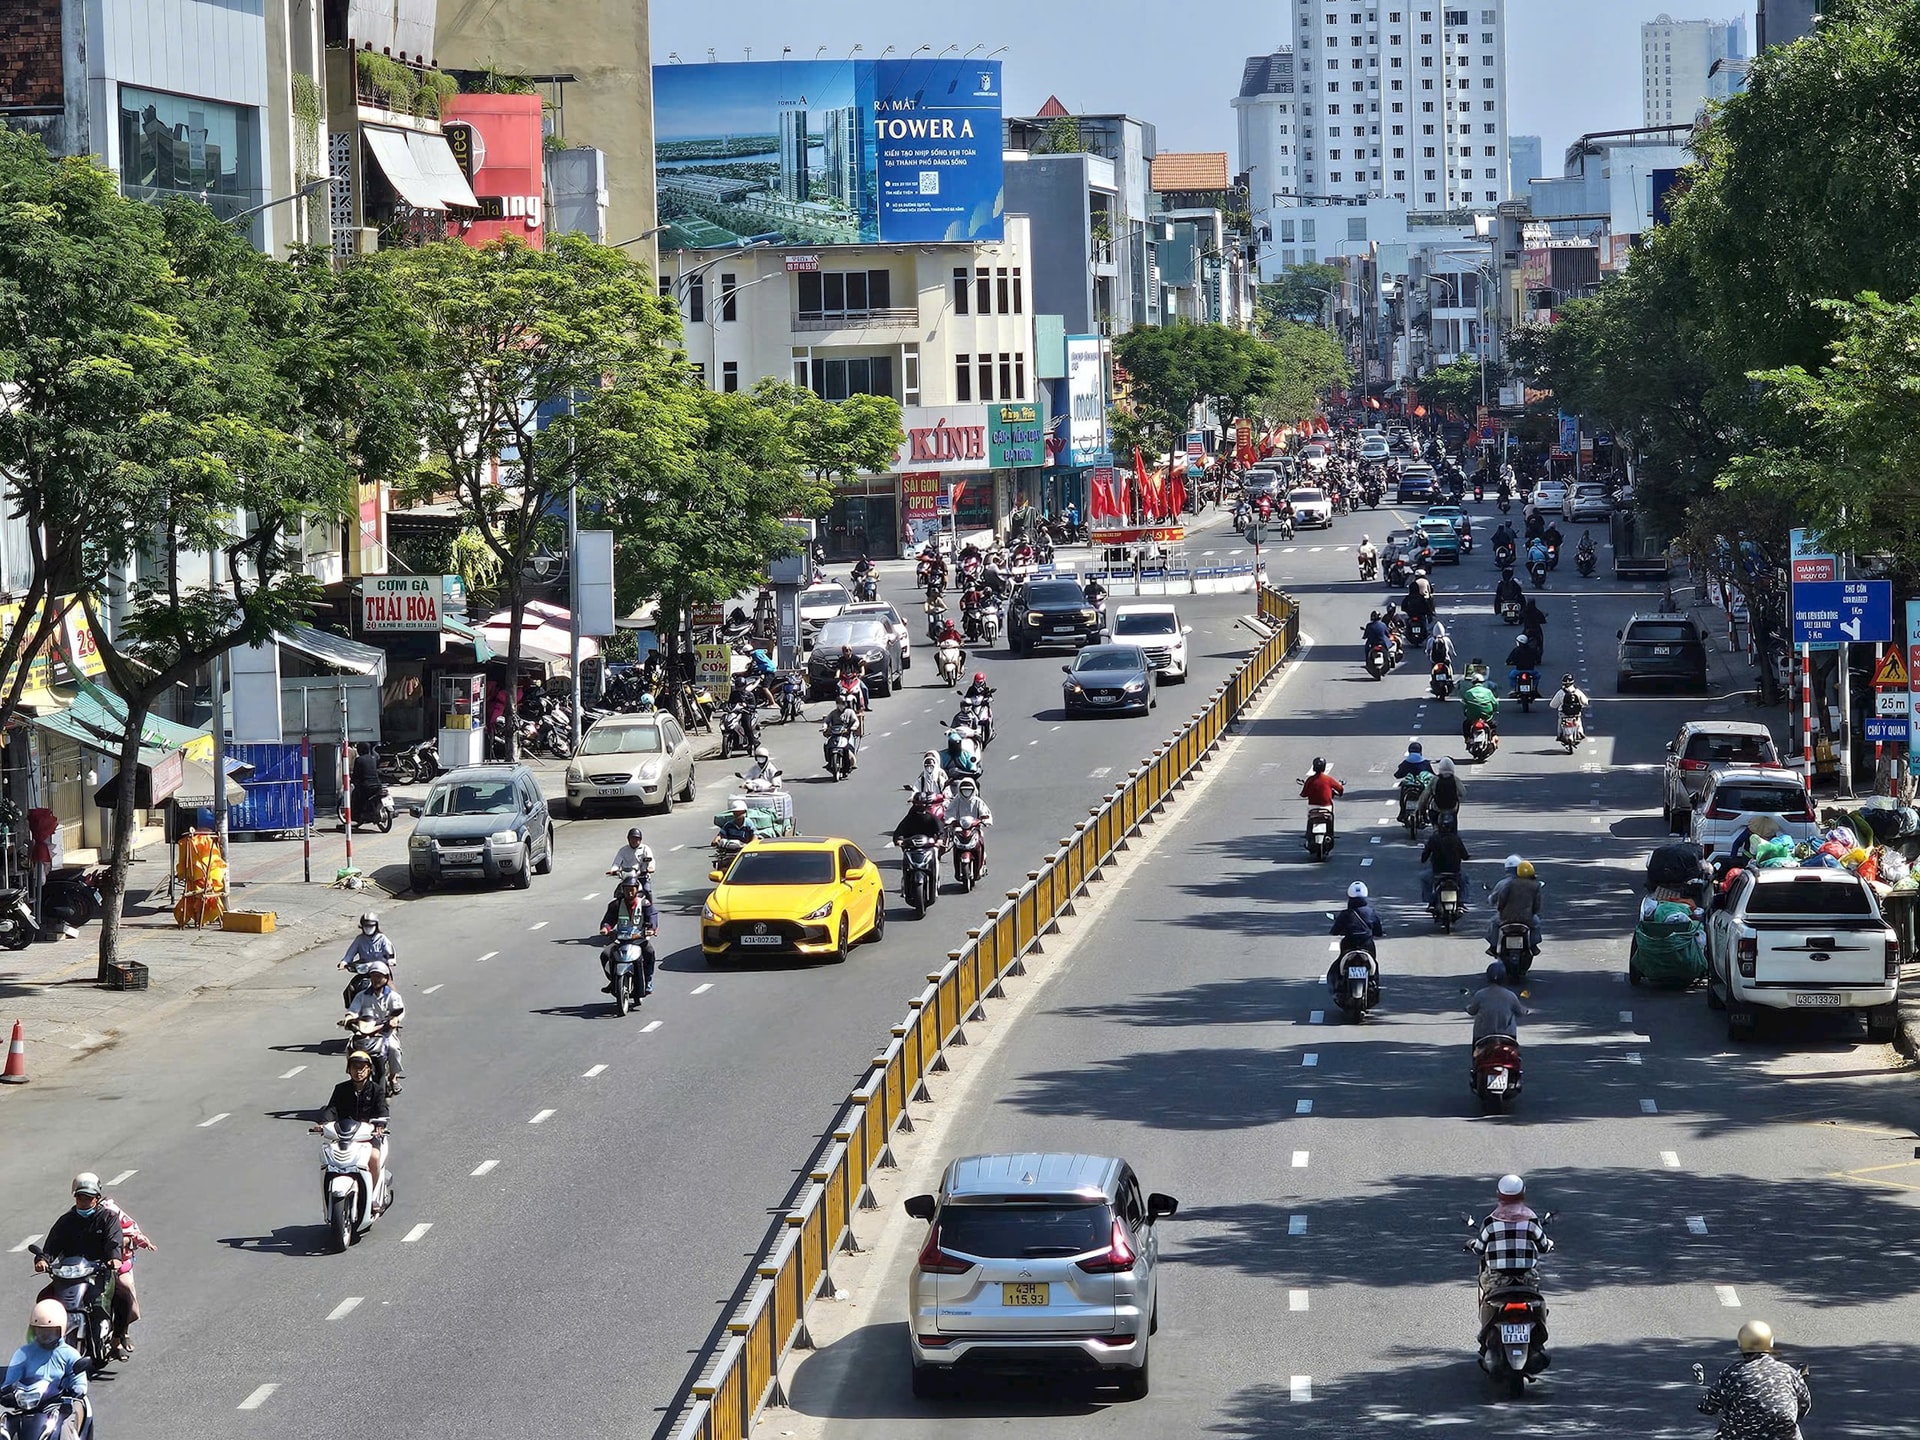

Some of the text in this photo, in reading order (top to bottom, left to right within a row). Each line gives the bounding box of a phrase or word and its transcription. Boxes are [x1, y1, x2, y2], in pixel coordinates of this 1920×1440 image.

[799, 95, 807, 105] A
[874, 100, 889, 111] RA
[875, 119, 974, 139] TOWER A
[910, 417, 986, 461] KÍNH
[909, 496, 934, 509] OPTIC
[377, 577, 430, 591] CƠM GÀ
[1851, 595, 1868, 604] MARKET
[365, 591, 437, 621] THÁI HÒA
[1808, 631, 1812, 639] 5
[76, 627, 96, 656] 28
[1881, 697, 1905, 709] 25 m
[1867, 721, 1906, 736] CHÚ Ý QUAN
[1016, 1284, 1036, 1294] 43H
[1009, 1294, 1044, 1304] 115.93
